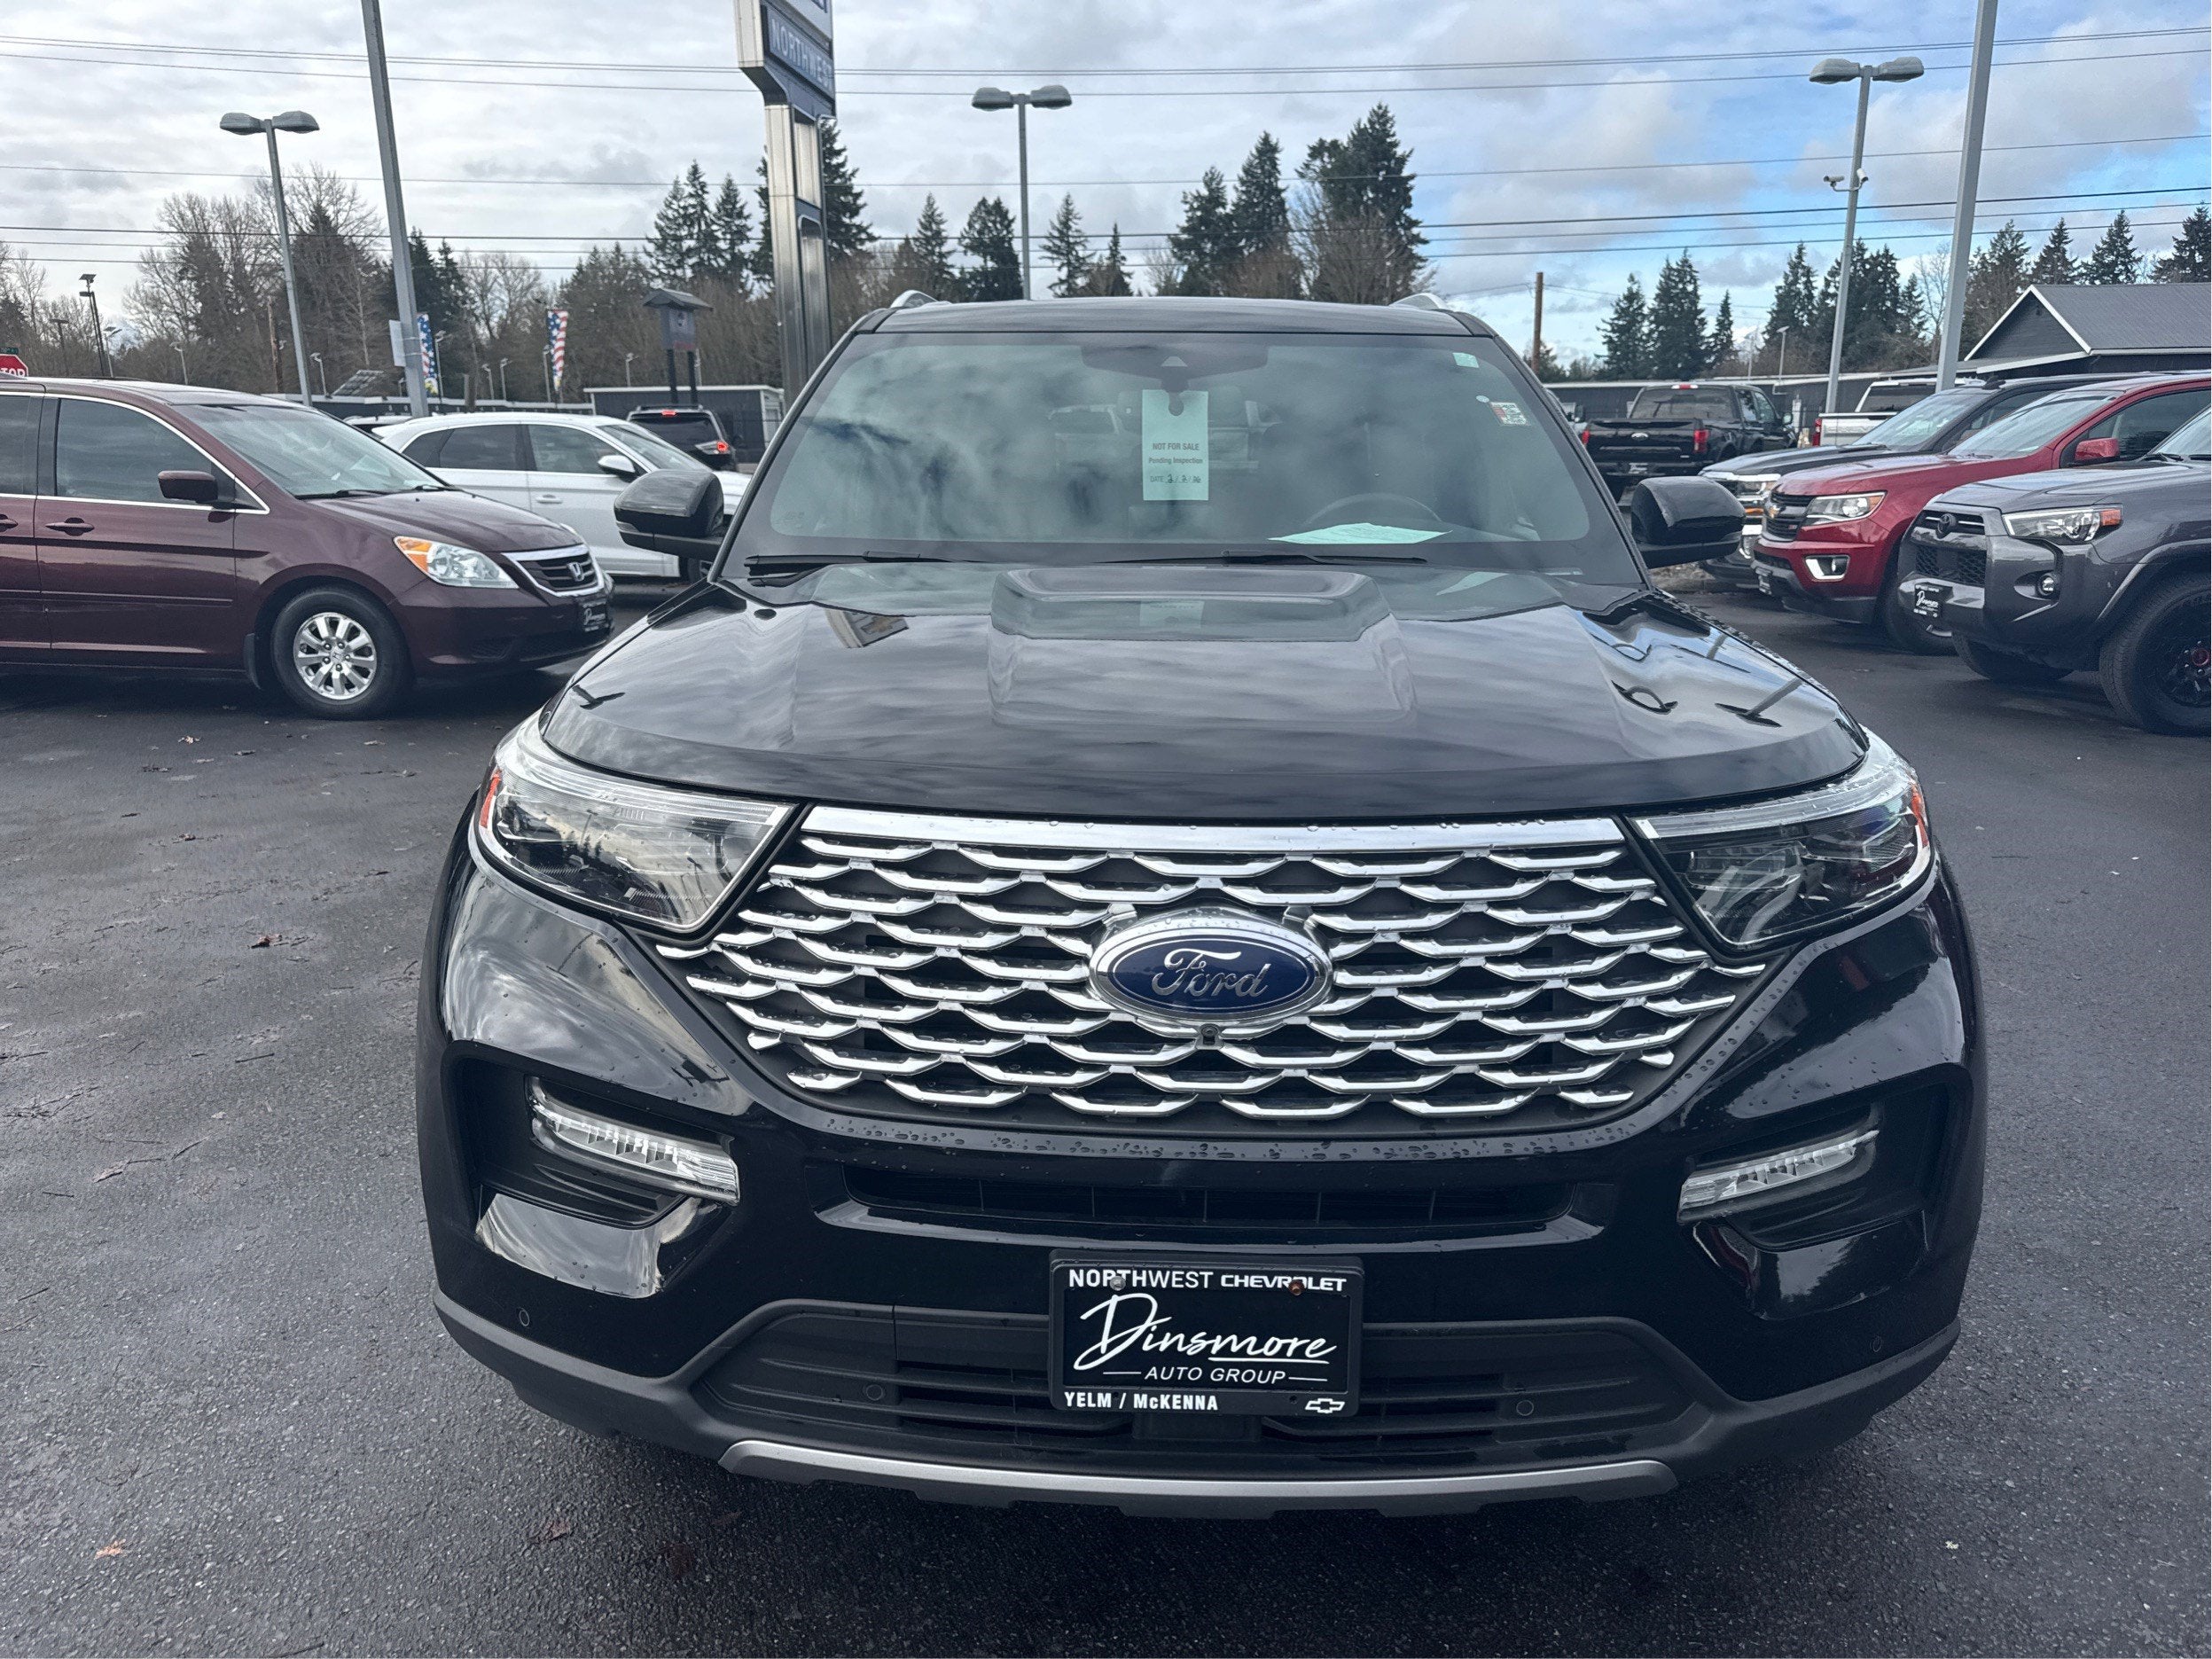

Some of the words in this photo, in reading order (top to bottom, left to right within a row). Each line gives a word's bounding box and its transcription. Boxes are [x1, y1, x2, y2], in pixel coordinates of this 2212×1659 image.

[771, 19, 832, 91] NORTHWEST
[1151, 948, 1271, 997] Ford
[1068, 1269, 1214, 1288] NORTHWEST
[1220, 1274, 1347, 1292] CHEVROLET
[1073, 1293, 1338, 1371] Dinsmore
[1145, 1366, 1203, 1381] AUTO
[1210, 1367, 1286, 1384] GROUP
[1065, 1392, 1111, 1408] YELM
[1133, 1393, 1218, 1411] McKENNA
